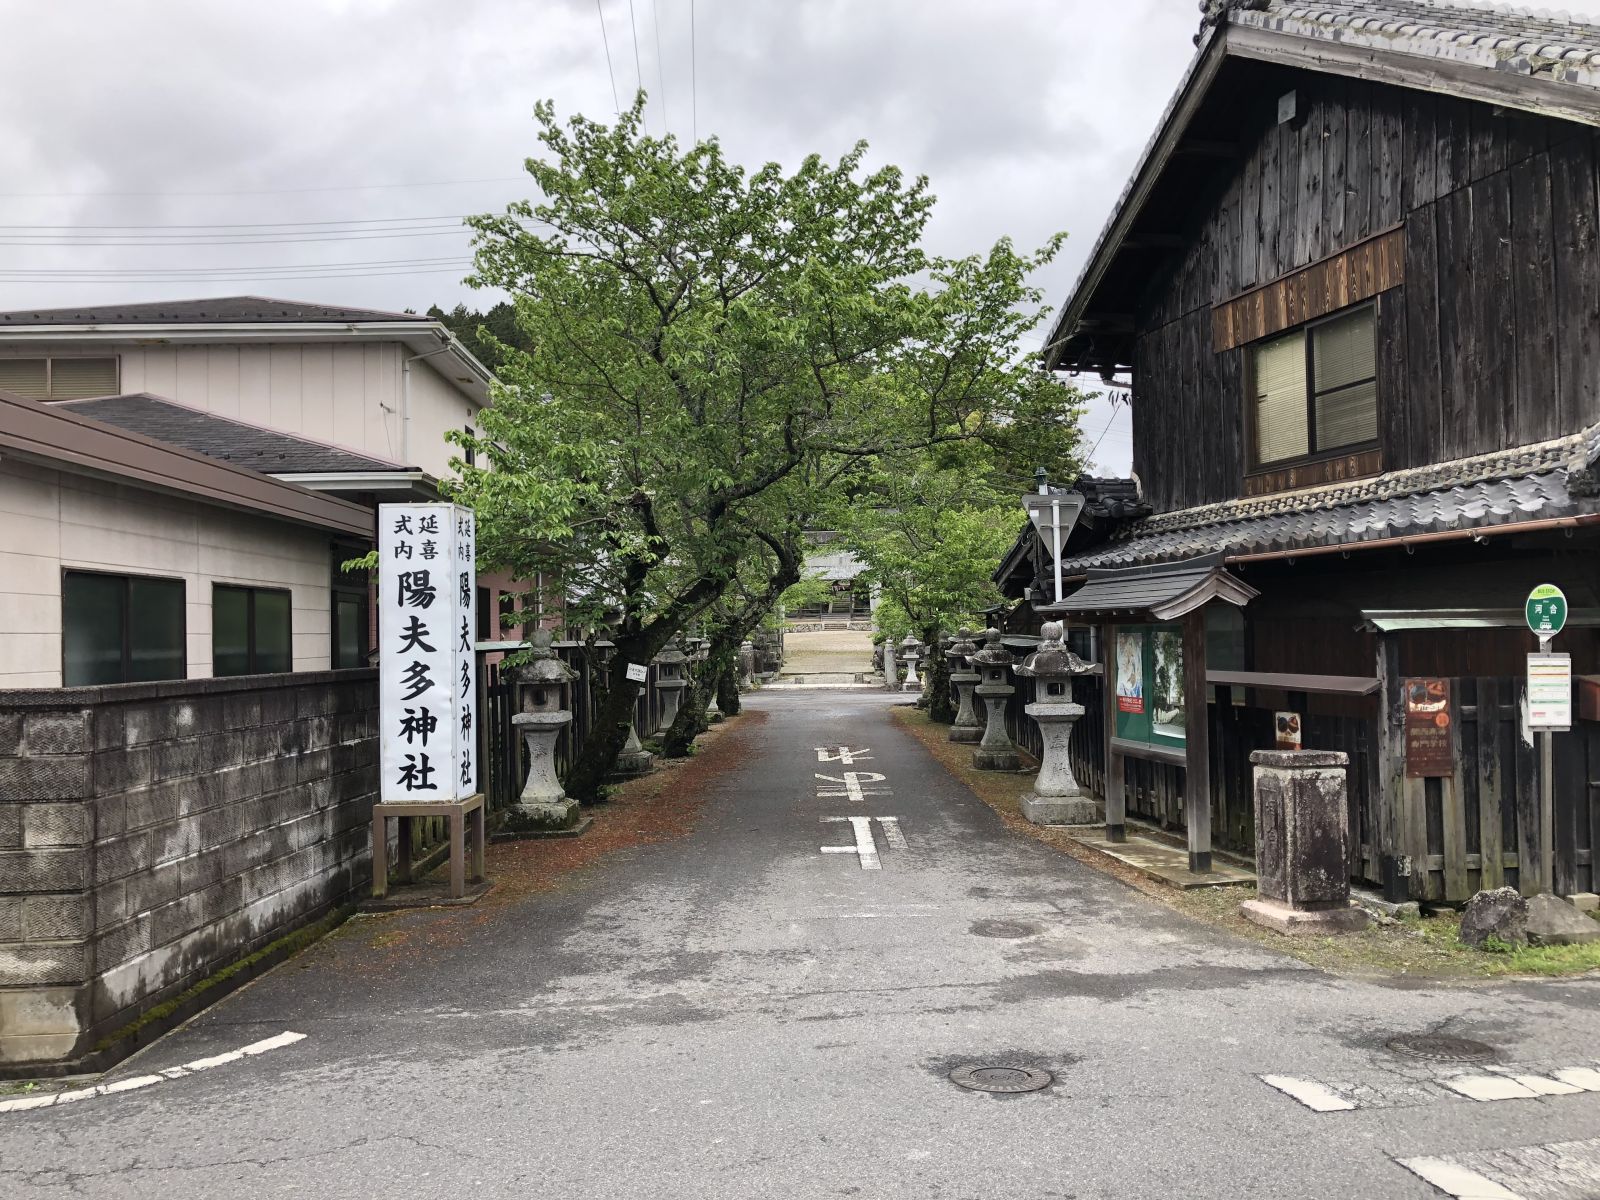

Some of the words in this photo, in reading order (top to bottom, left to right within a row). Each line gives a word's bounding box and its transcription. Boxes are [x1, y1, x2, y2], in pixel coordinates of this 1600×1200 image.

[393, 514, 413, 560] 式内
[418, 514, 439, 560] 延喜
[1534, 604, 1558, 614] 河合
[397, 569, 438, 792] 陽夫多神社
[459, 571, 472, 787] 陽夫多神社
